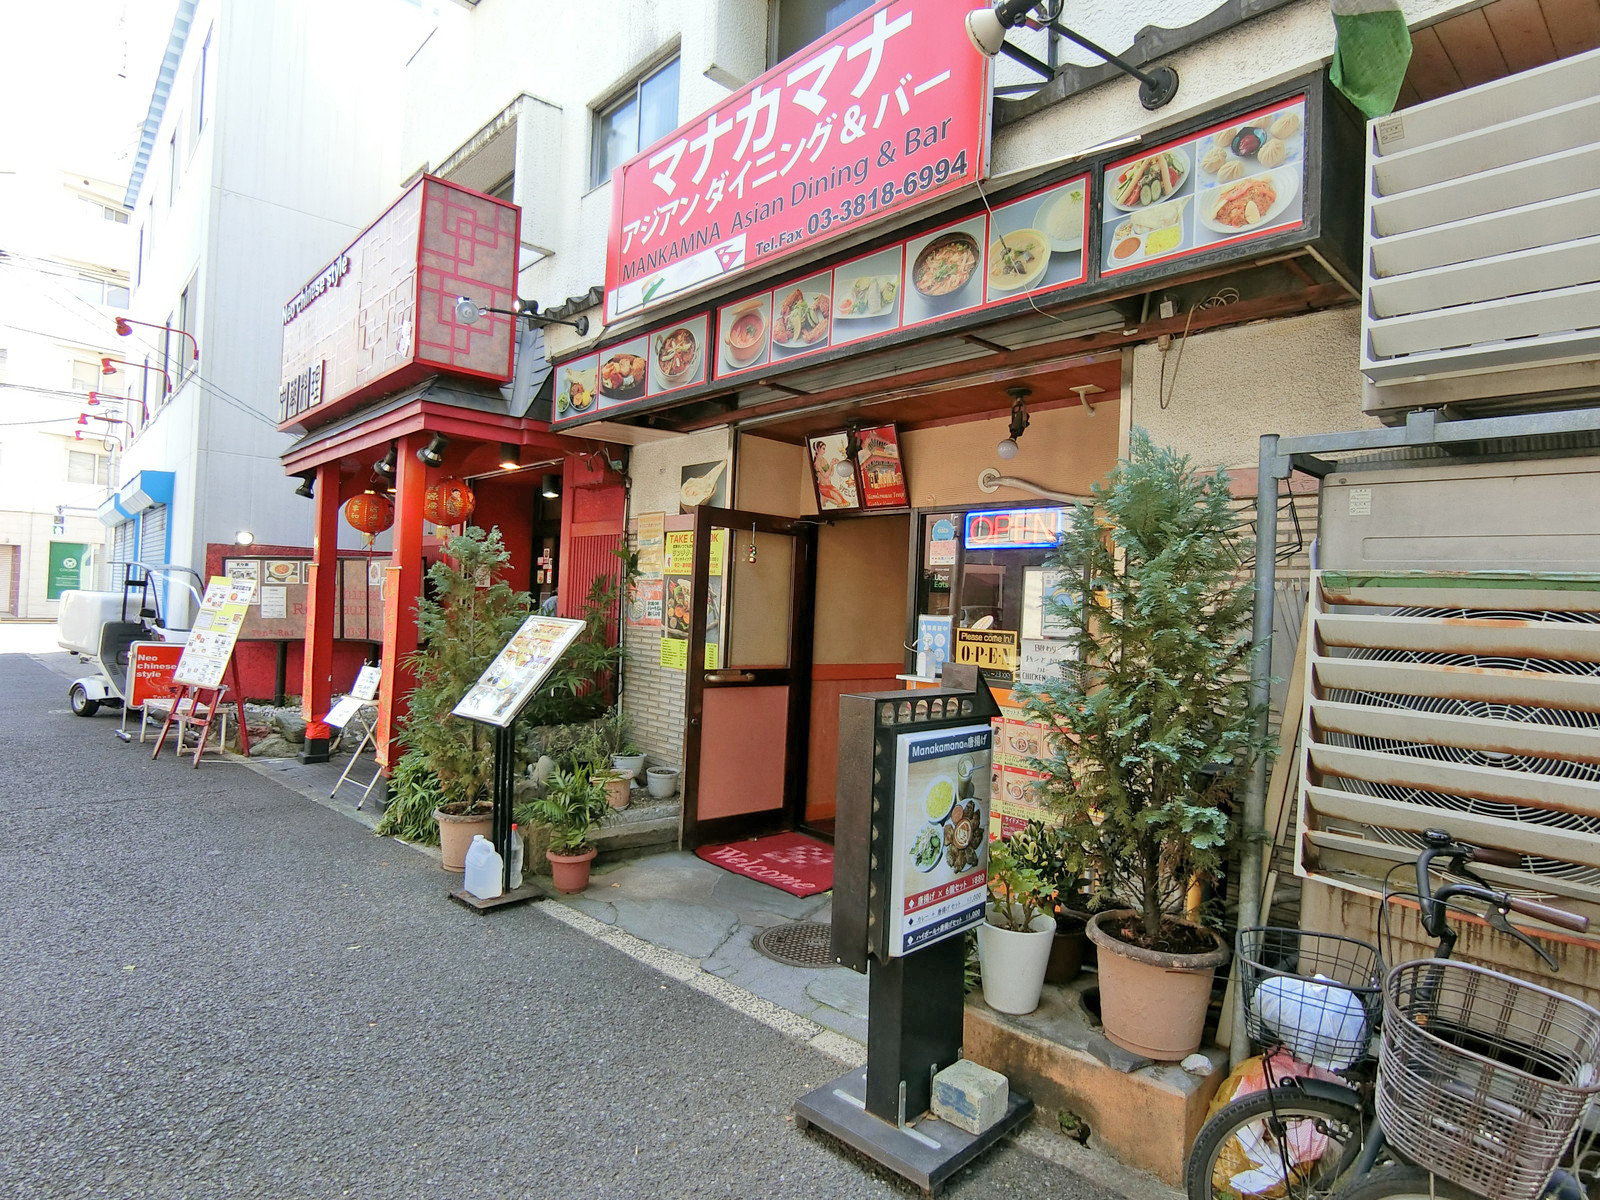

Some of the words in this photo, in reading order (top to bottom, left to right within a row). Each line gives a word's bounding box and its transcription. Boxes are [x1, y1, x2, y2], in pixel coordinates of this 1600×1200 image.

[648, 8, 913, 196] マナカマナ
[622, 222, 721, 282] MANKAMNA
[730, 194, 784, 234] Asian
[791, 158, 869, 208] Dining
[876, 140, 896, 167] &
[904, 116, 952, 157] Bar
[807, 150, 968, 236] 03-3818-6994
[281, 304, 297, 326] Neo
[326, 254, 350, 287] style
[670, 534, 688, 544] TAKE
[970, 513, 1055, 544] OPEN
[961, 632, 983, 641] Please
[983, 635, 1003, 643] come
[136, 671, 162, 679] style
[710, 846, 816, 889] Welcome
